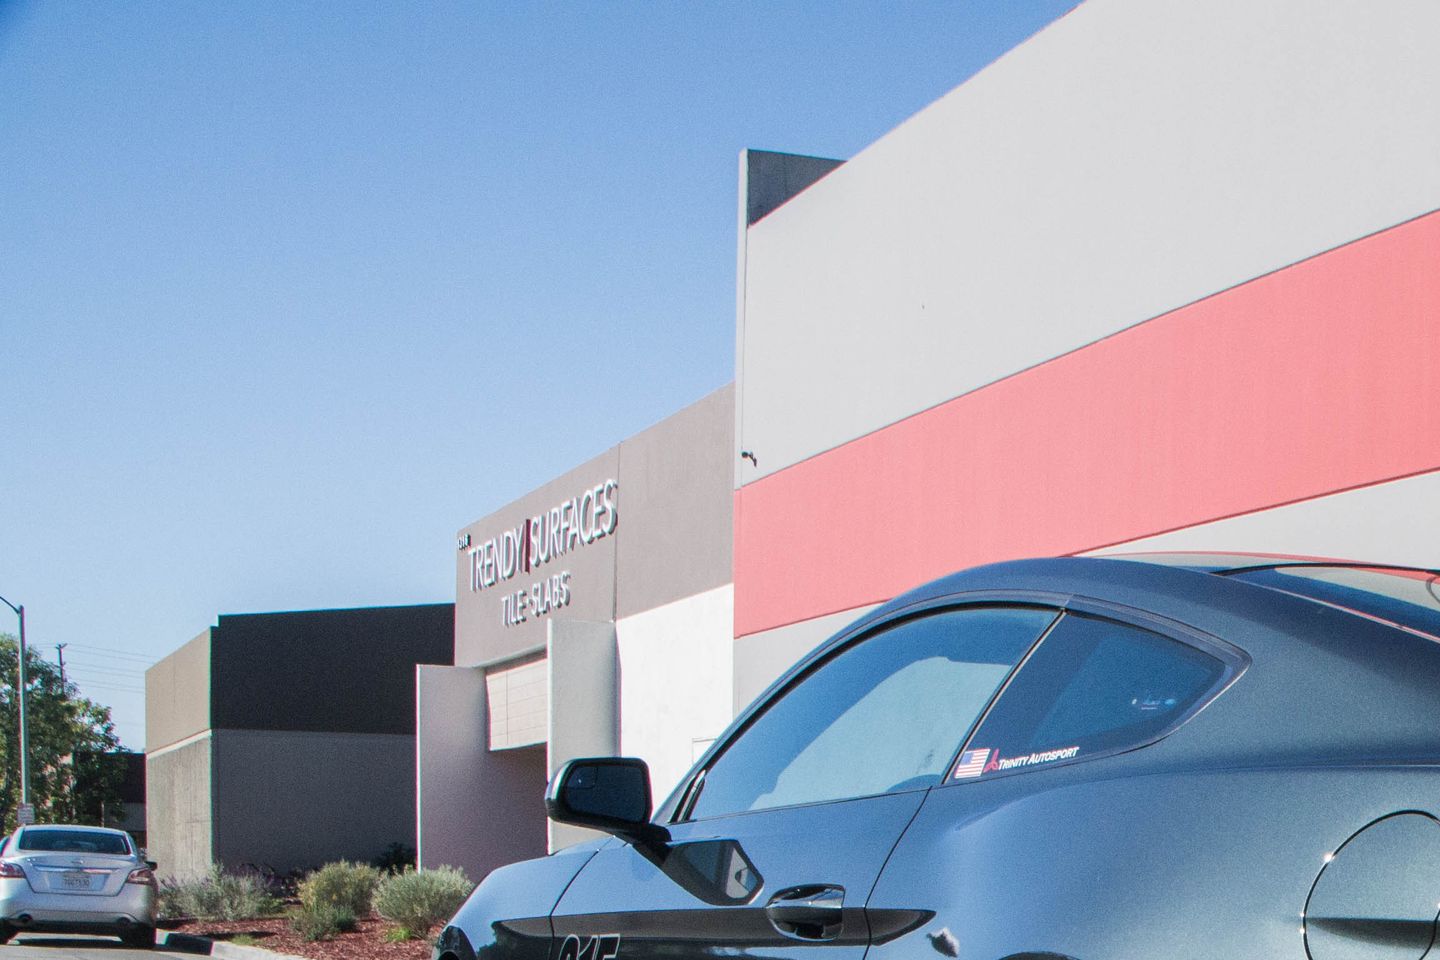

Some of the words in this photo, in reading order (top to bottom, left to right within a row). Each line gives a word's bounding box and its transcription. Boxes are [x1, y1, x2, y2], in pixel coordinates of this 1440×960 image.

[468, 524, 524, 593] TRENDY
[529, 478, 619, 567] SURFACES
[501, 590, 527, 627] TILE
[531, 571, 571, 616] SLABS
[998, 756, 1029, 770] TRINITY
[1027, 746, 1080, 765] AUTOSPORT
